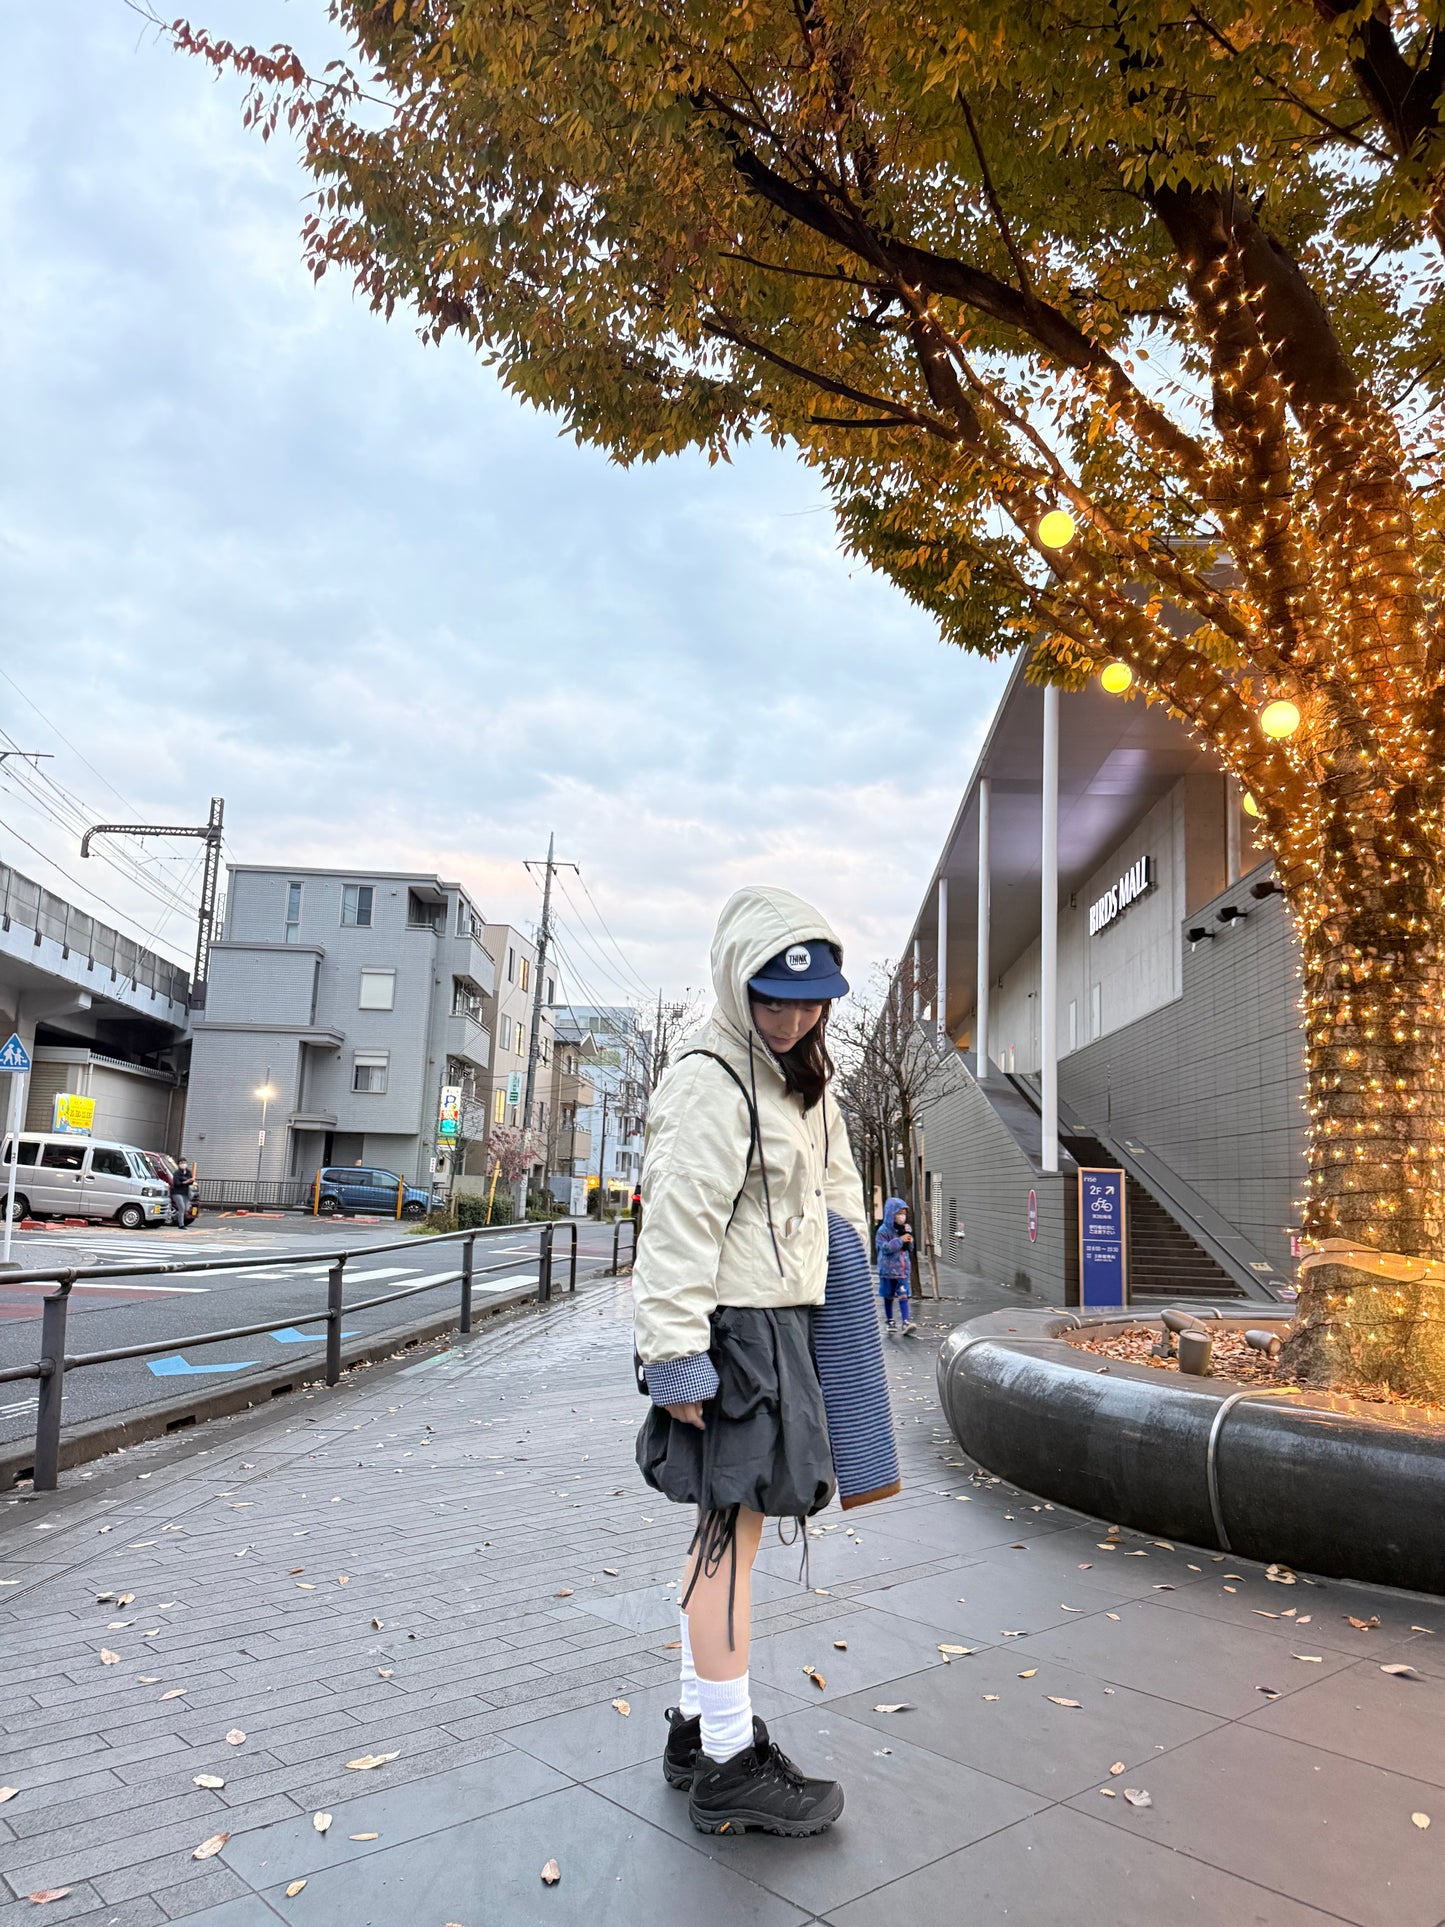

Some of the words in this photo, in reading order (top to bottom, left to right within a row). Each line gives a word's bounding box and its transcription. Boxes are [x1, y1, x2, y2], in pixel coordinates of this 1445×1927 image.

[1090, 884, 1118, 936] BIRDS
[1119, 855, 1148, 911] MALL
[788, 954, 808, 965] THINK
[1089, 1185, 1102, 1195] 2F
